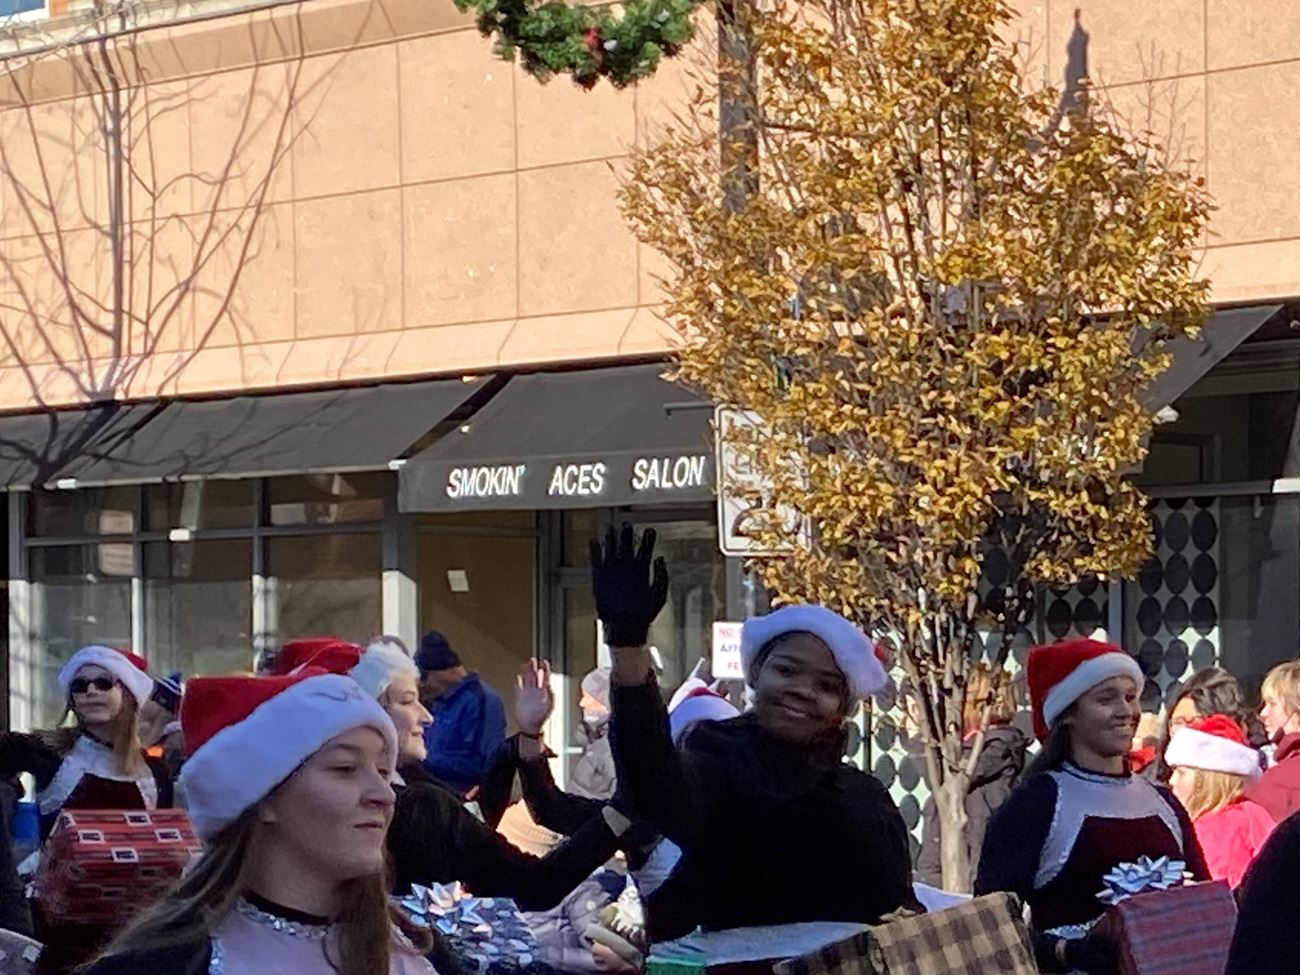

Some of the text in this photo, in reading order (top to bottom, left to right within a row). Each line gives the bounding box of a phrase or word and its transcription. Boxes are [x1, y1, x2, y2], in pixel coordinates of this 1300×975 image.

[447, 455, 706, 498] SMOKIN' ACES SALON
